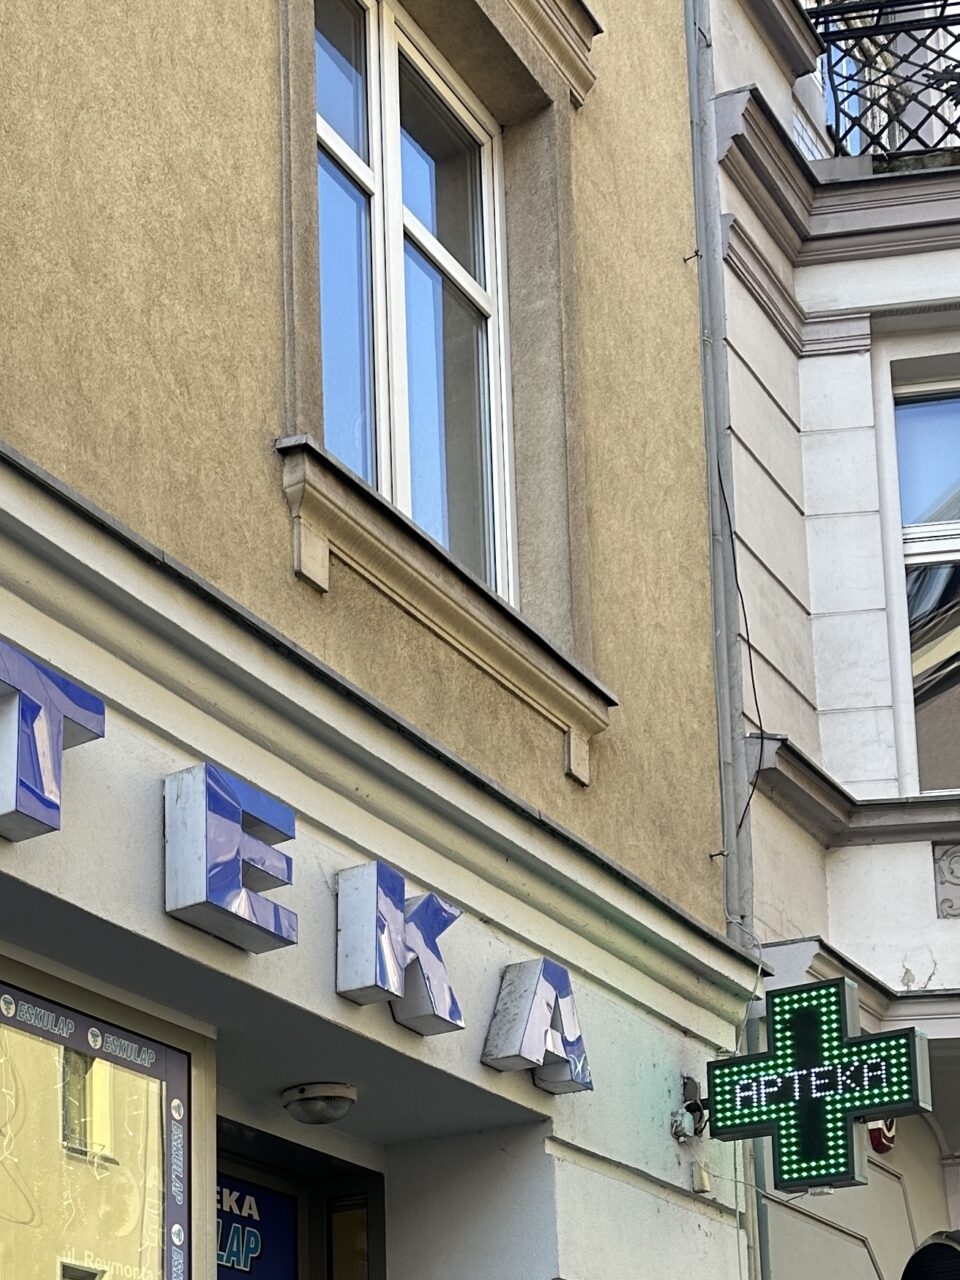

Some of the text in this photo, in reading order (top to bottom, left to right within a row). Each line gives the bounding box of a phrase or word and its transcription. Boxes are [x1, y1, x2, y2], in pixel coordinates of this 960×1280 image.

[16, 1001, 75, 1039] ESKULAP
[104, 1033, 156, 1067] ESKULAP
[735, 1058, 887, 1110] APTEKA
